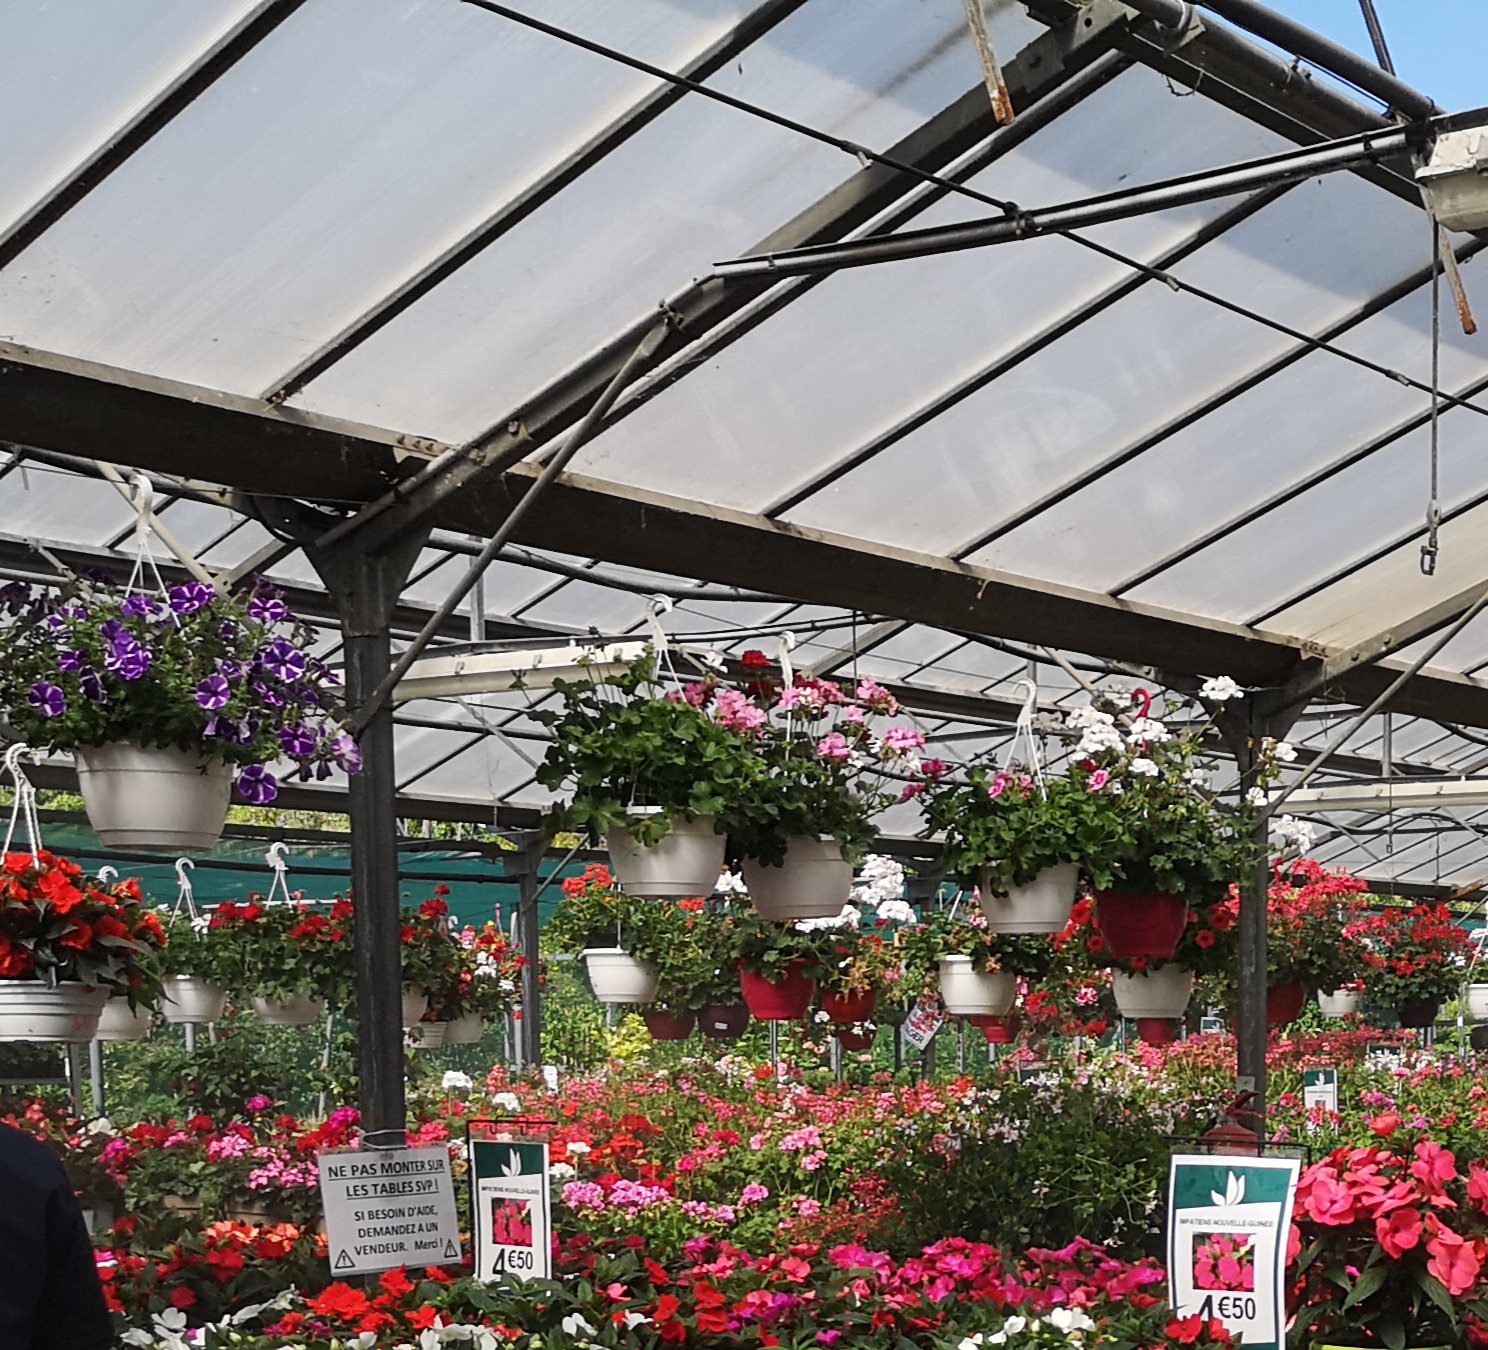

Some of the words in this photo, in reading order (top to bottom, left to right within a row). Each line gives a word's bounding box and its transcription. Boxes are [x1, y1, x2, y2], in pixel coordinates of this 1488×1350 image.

[328, 1165, 347, 1178] NE
[351, 1163, 377, 1176] PAS
[380, 1160, 426, 1174] MONTER
[427, 1159, 445, 1171] SUR
[346, 1184, 368, 1197] LES
[371, 1180, 414, 1195] TABLES
[415, 1179, 433, 1192] SVP
[354, 1210, 365, 1221] SI
[368, 1208, 405, 1220] BESOIN
[358, 1223, 416, 1239] DEMANDEZ
[417, 1223, 424, 1232] A
[425, 1222, 438, 1232] UN
